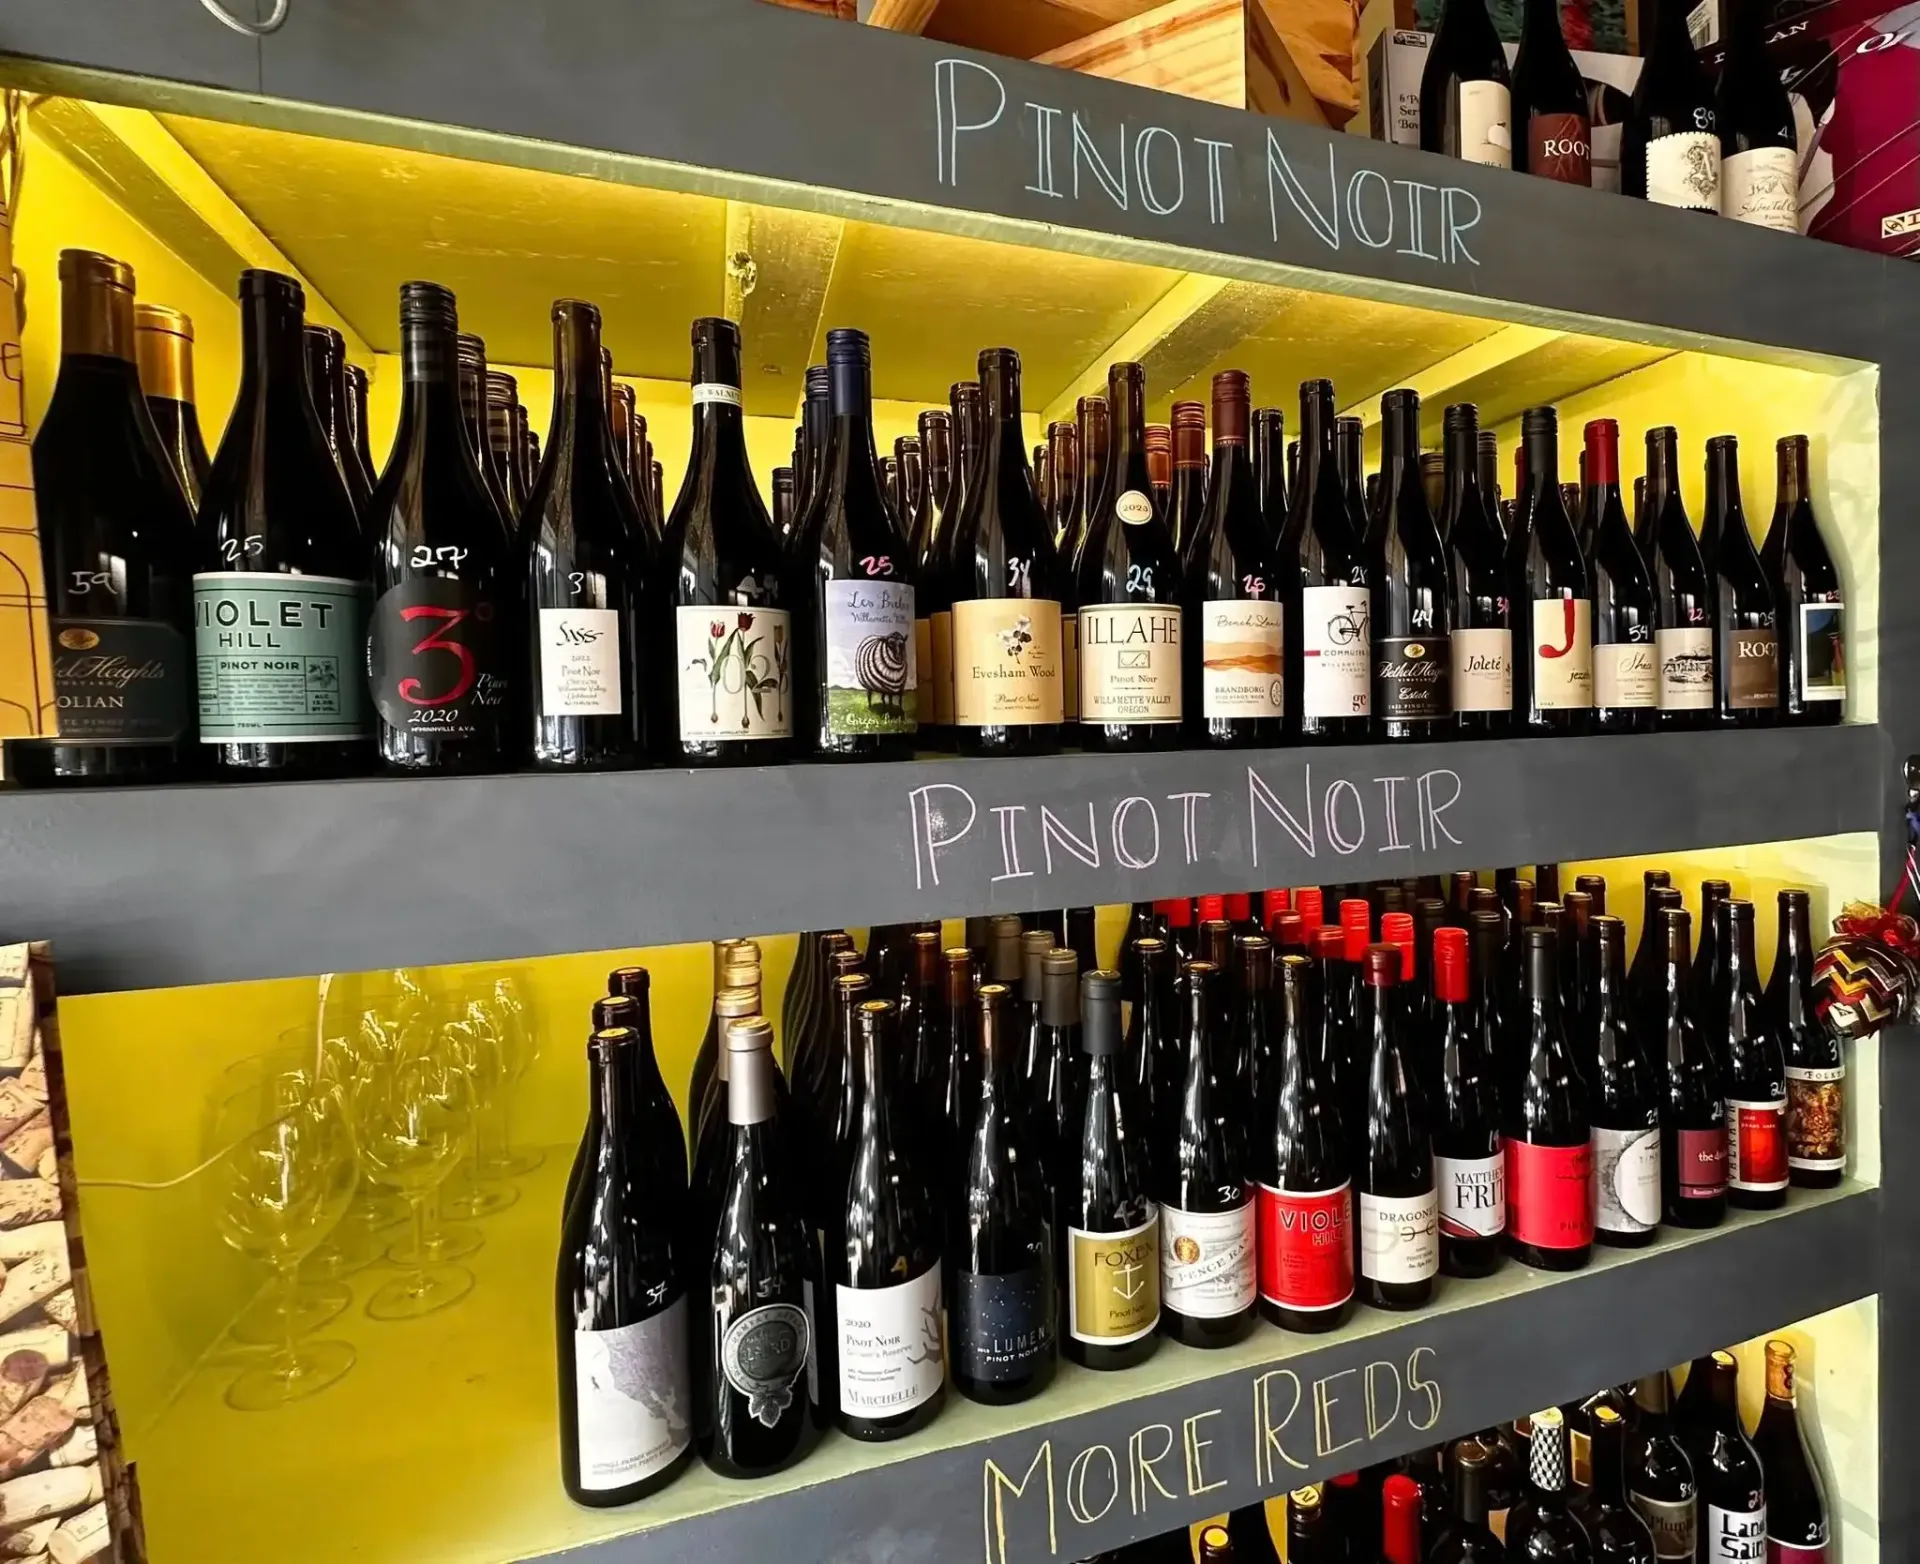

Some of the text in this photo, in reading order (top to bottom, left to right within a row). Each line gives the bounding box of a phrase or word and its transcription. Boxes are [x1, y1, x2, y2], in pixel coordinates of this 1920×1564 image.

[1693, 106, 1717, 131] 89
[935, 59, 1482, 266] PINOT NOIR
[221, 535, 265, 562] 25
[410, 545, 468, 570] 27
[859, 555, 894, 576] 25
[68, 571, 119, 596] 59
[1087, 616, 1178, 645] ILLAHE
[1629, 624, 1649, 642] 54
[219, 632, 281, 649] HILL
[220, 661, 300, 670] PINOT NOIR
[972, 663, 1055, 679] Evesham Wood
[1463, 655, 1502, 673] Joleté
[1110, 674, 1158, 684] Pinot Noir
[1215, 686, 1265, 694] BRANDBORG
[1398, 686, 1431, 700] Estate
[1093, 696, 1171, 705] WILLAMETTE VALLEY
[407, 709, 459, 723] 2020
[1117, 705, 1150, 715] OREGON
[909, 764, 1463, 889] PINOT NOIR
[1698, 1151, 1714, 1162] the
[1218, 1184, 1240, 1204] 30
[646, 1280, 668, 1306] 37
[845, 1318, 872, 1329] 2020
[846, 1333, 901, 1348] PINOT NOIR
[985, 1354, 1015, 1363] PINOT
[983, 1346, 1442, 1564] MORE REDS
